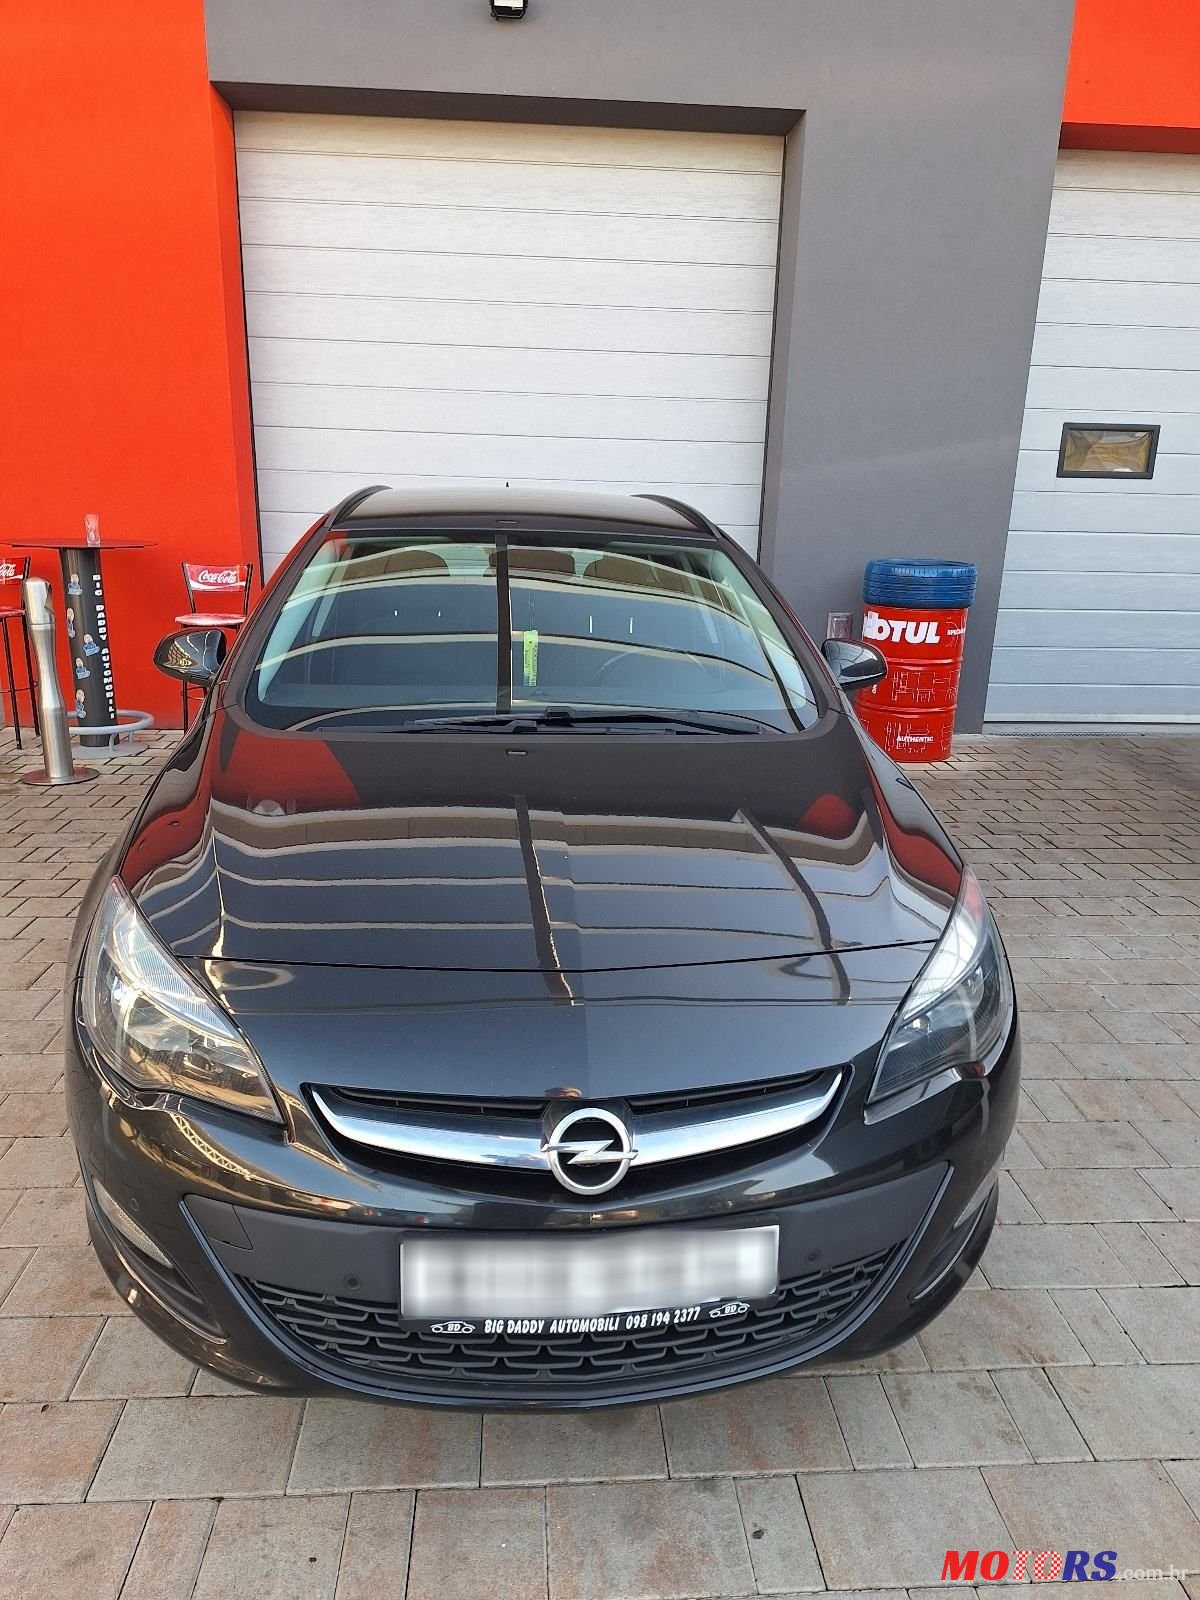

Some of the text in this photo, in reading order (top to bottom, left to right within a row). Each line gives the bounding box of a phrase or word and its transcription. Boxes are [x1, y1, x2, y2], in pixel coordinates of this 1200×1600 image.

[92, 574, 115, 720] BIG DADDY AUTOMOBILI
[484, 1319, 506, 1334] BIG
[506, 1319, 545, 1334] DADDY
[549, 1316, 620, 1334] AUTOMOBILI
[625, 1313, 649, 1330] 098
[650, 1311, 671, 1327] 194
[673, 1306, 701, 1324] 2377
